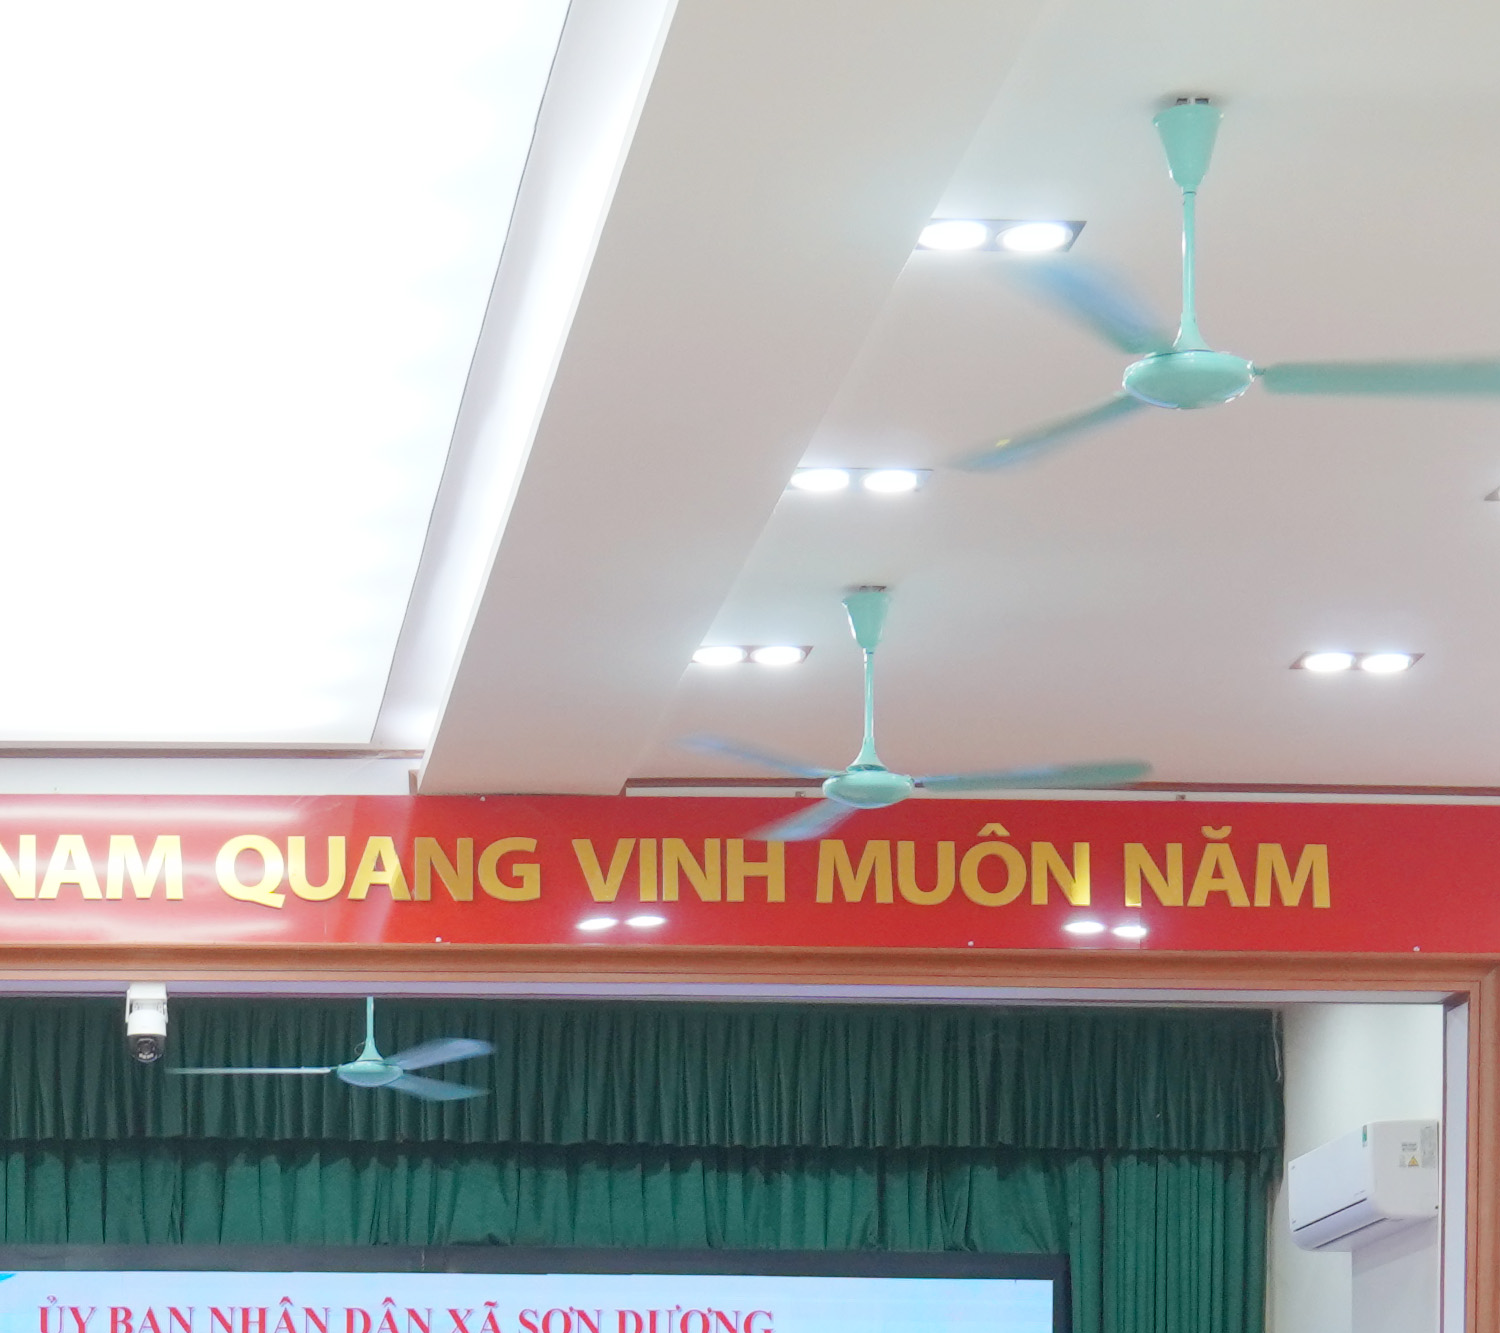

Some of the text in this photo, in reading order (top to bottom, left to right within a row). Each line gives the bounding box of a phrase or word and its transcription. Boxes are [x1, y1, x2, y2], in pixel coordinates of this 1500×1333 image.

[215, 835, 542, 909] QUANG
[574, 836, 786, 904] VINH
[815, 823, 1091, 907] MUÔN
[1125, 825, 1331, 910] NĂM
